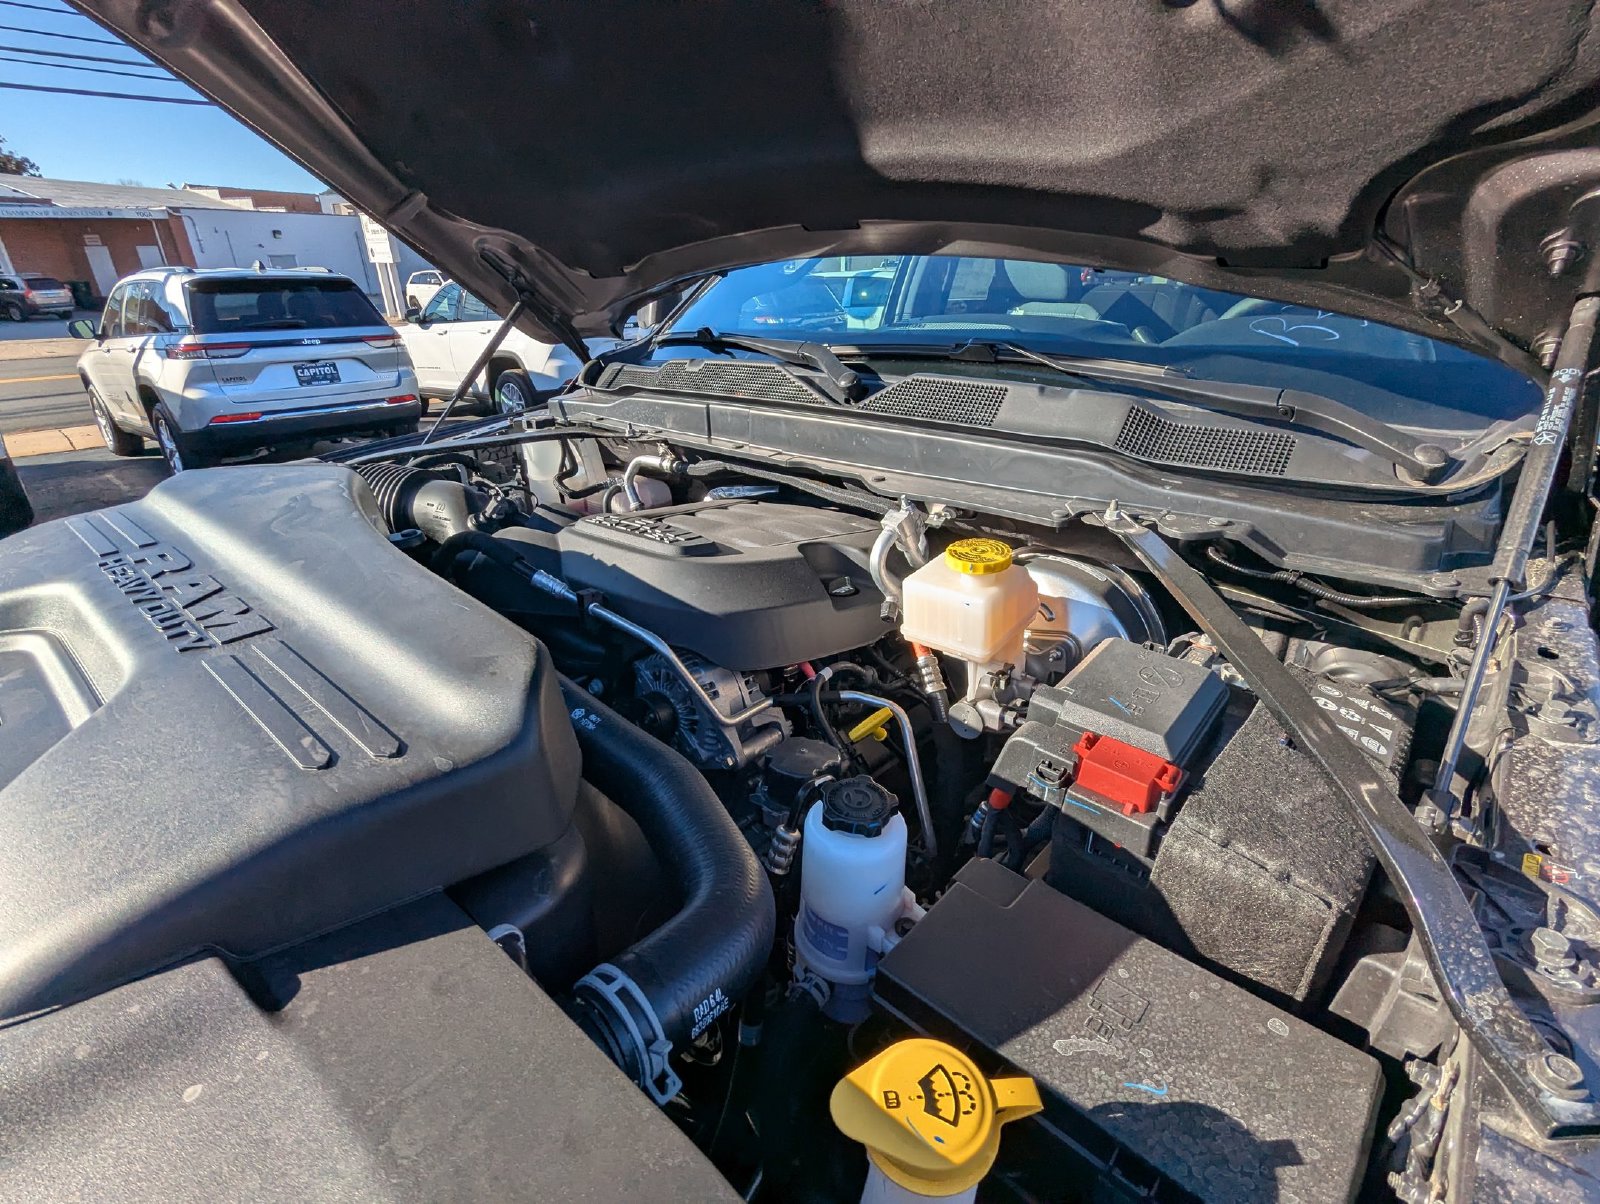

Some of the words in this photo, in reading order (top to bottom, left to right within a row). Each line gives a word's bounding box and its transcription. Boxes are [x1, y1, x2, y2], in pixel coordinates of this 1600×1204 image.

[297, 366, 337, 376] CAPITOL
[1552, 368, 1582, 378] BODY
[98, 558, 165, 604] HEAVY
[138, 603, 216, 652] DUTY
[127, 546, 277, 645] RAM
